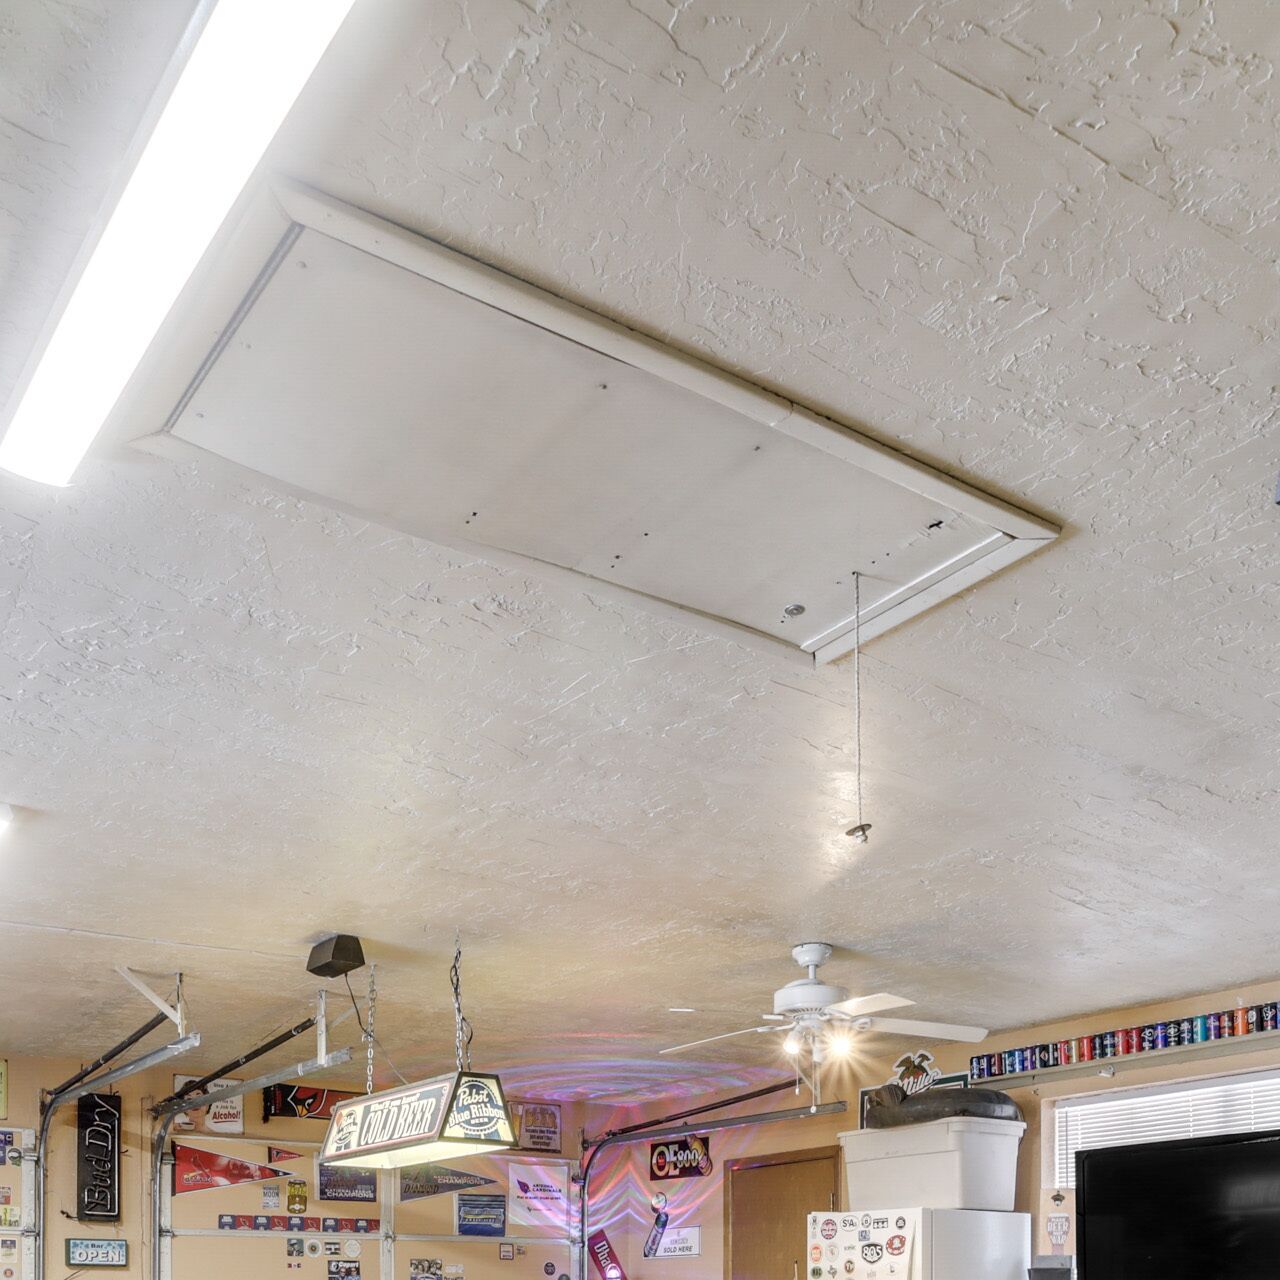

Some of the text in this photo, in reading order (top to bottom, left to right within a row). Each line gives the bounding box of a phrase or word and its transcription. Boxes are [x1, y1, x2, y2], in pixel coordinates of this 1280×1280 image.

[896, 1073, 941, 1095] Miller
[458, 1088, 489, 1107] Pabst
[85, 1094, 119, 1148] Dry
[212, 1110, 241, 1121] Alcohol!
[360, 1098, 436, 1145] COLD BEER
[449, 1104, 506, 1128] Blue Ribbon
[85, 1155, 111, 1211] Bud
[1047, 1222, 1069, 1232] BEER
[76, 1250, 120, 1262] OPEN
[678, 1245, 693, 1253] HERE
[863, 1246, 882, 1257] 805
